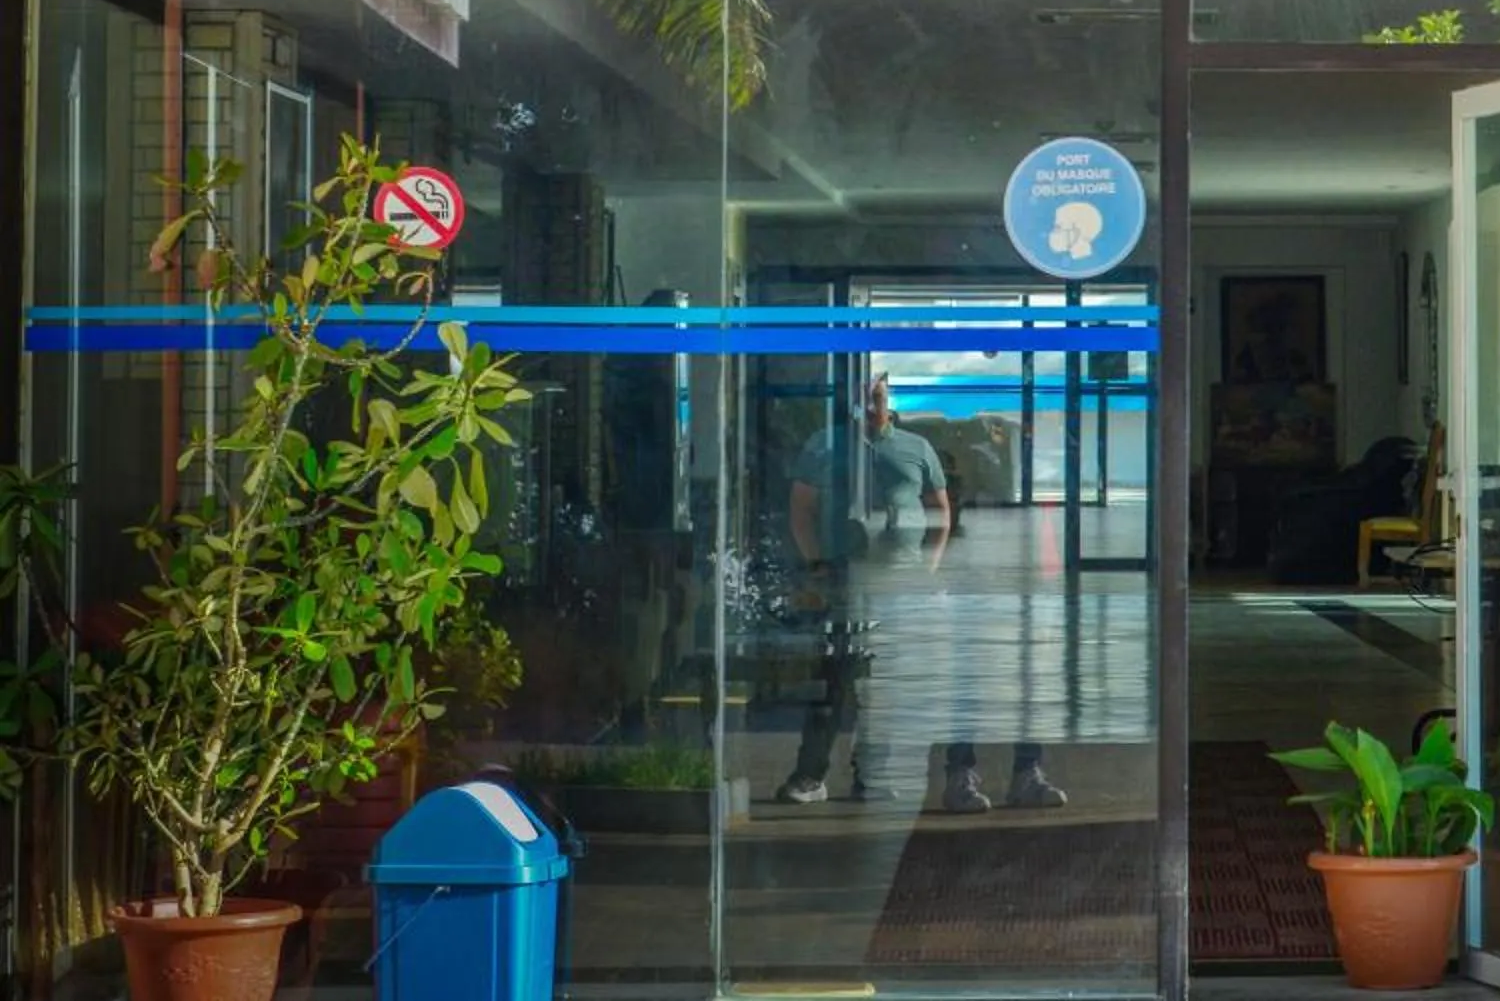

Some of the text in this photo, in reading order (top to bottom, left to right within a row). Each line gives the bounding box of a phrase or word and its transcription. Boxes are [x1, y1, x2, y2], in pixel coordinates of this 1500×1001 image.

[1056, 154, 1091, 166] PORT
[1036, 168, 1112, 181] DU MASQUE
[1031, 182, 1117, 197] OBLIGATOIRE
